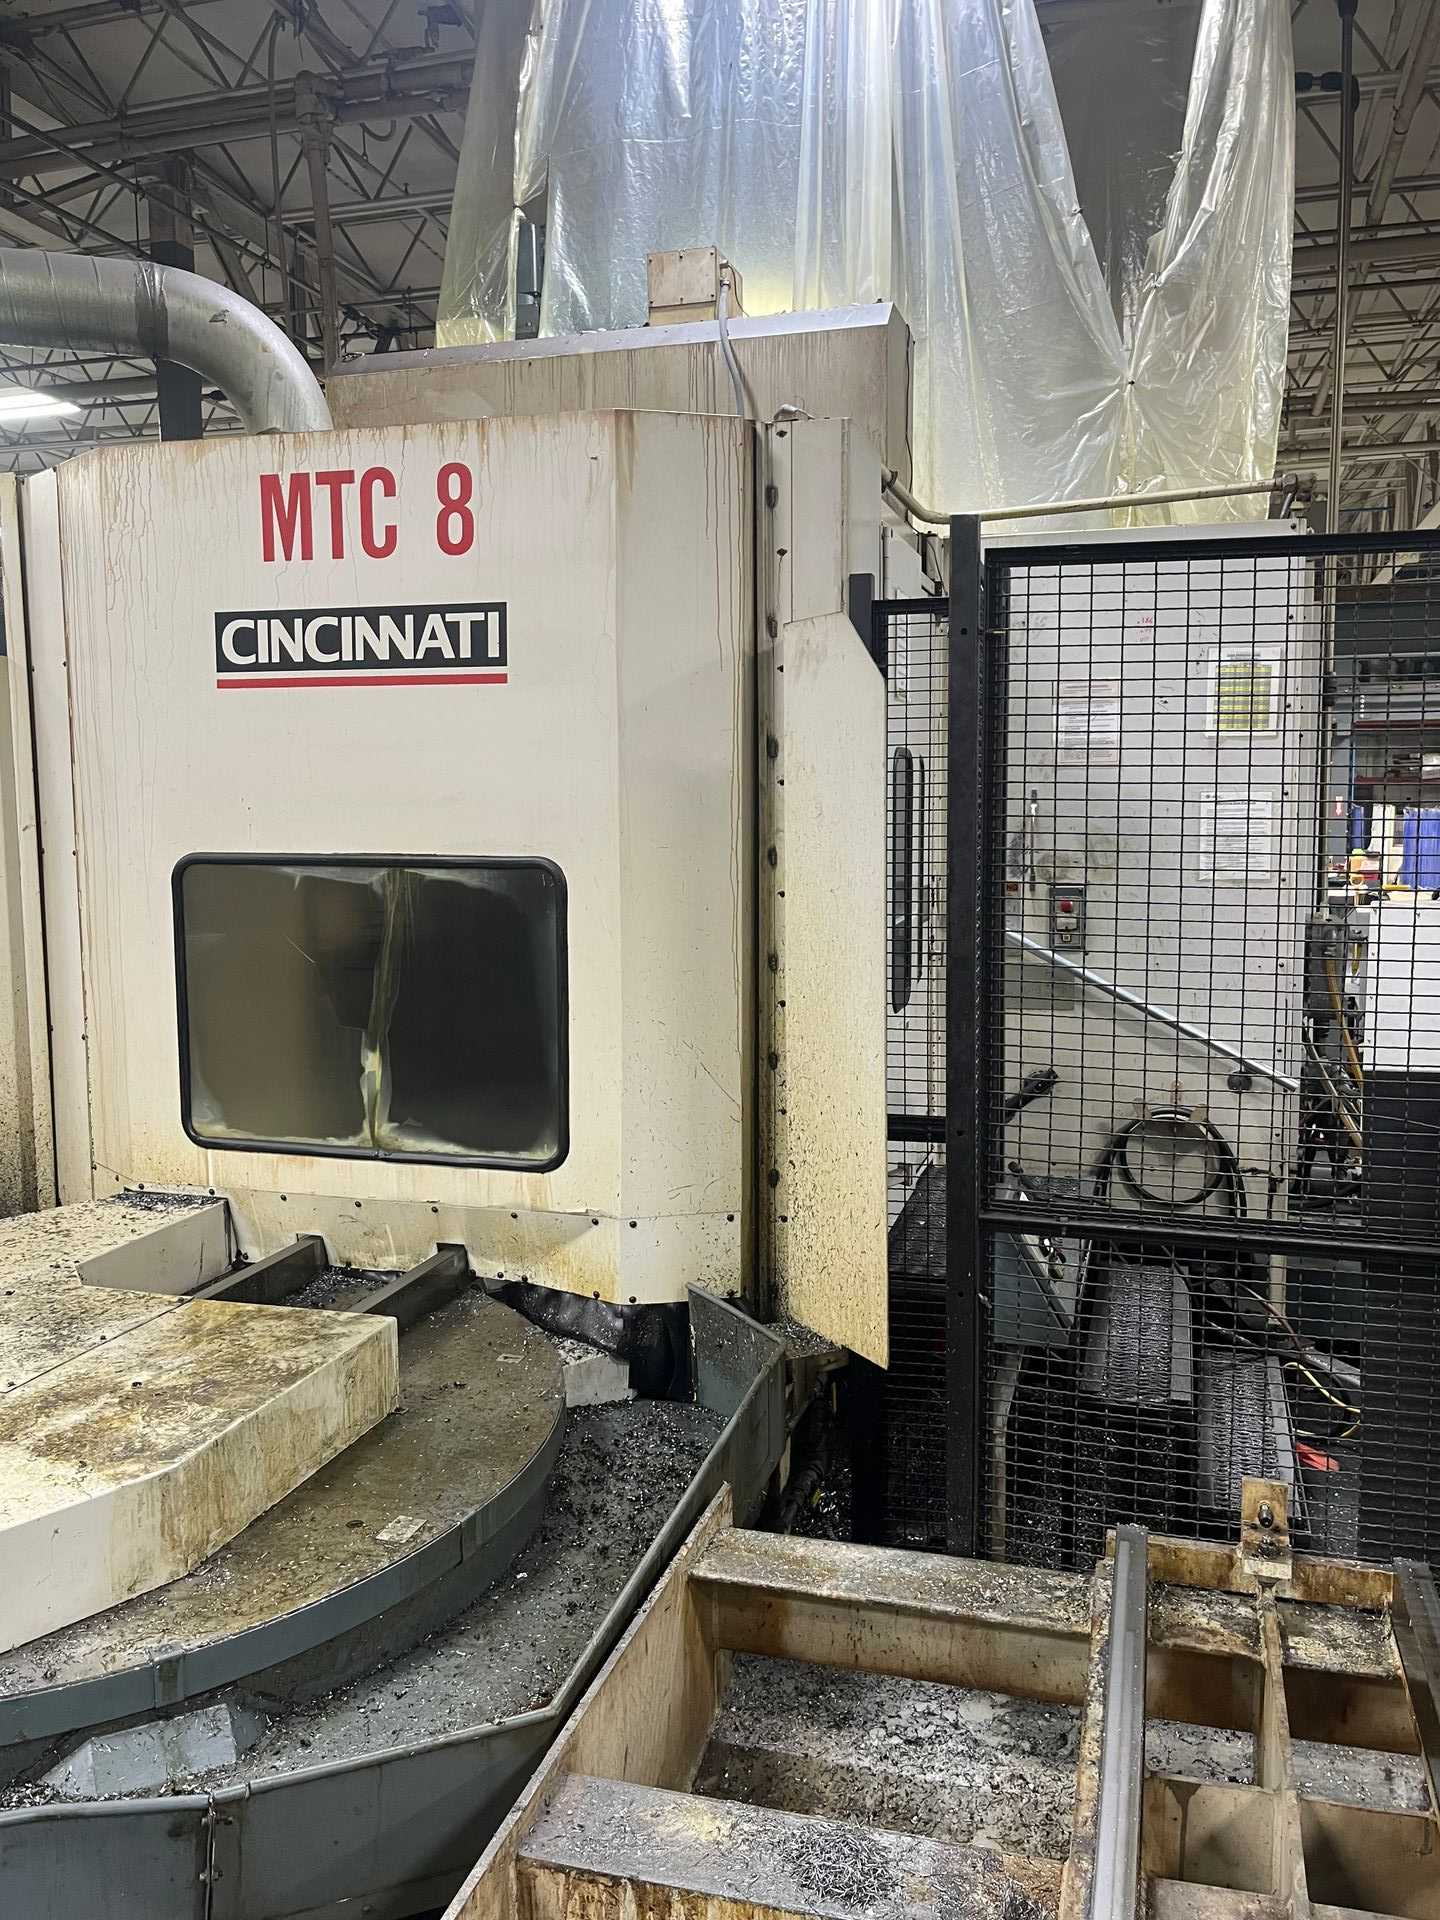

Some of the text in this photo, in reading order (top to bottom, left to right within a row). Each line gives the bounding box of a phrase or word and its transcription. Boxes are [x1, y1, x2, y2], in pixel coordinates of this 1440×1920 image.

[260, 462, 474, 562] MTC 8
[221, 611, 500, 665] CINCINNATI
